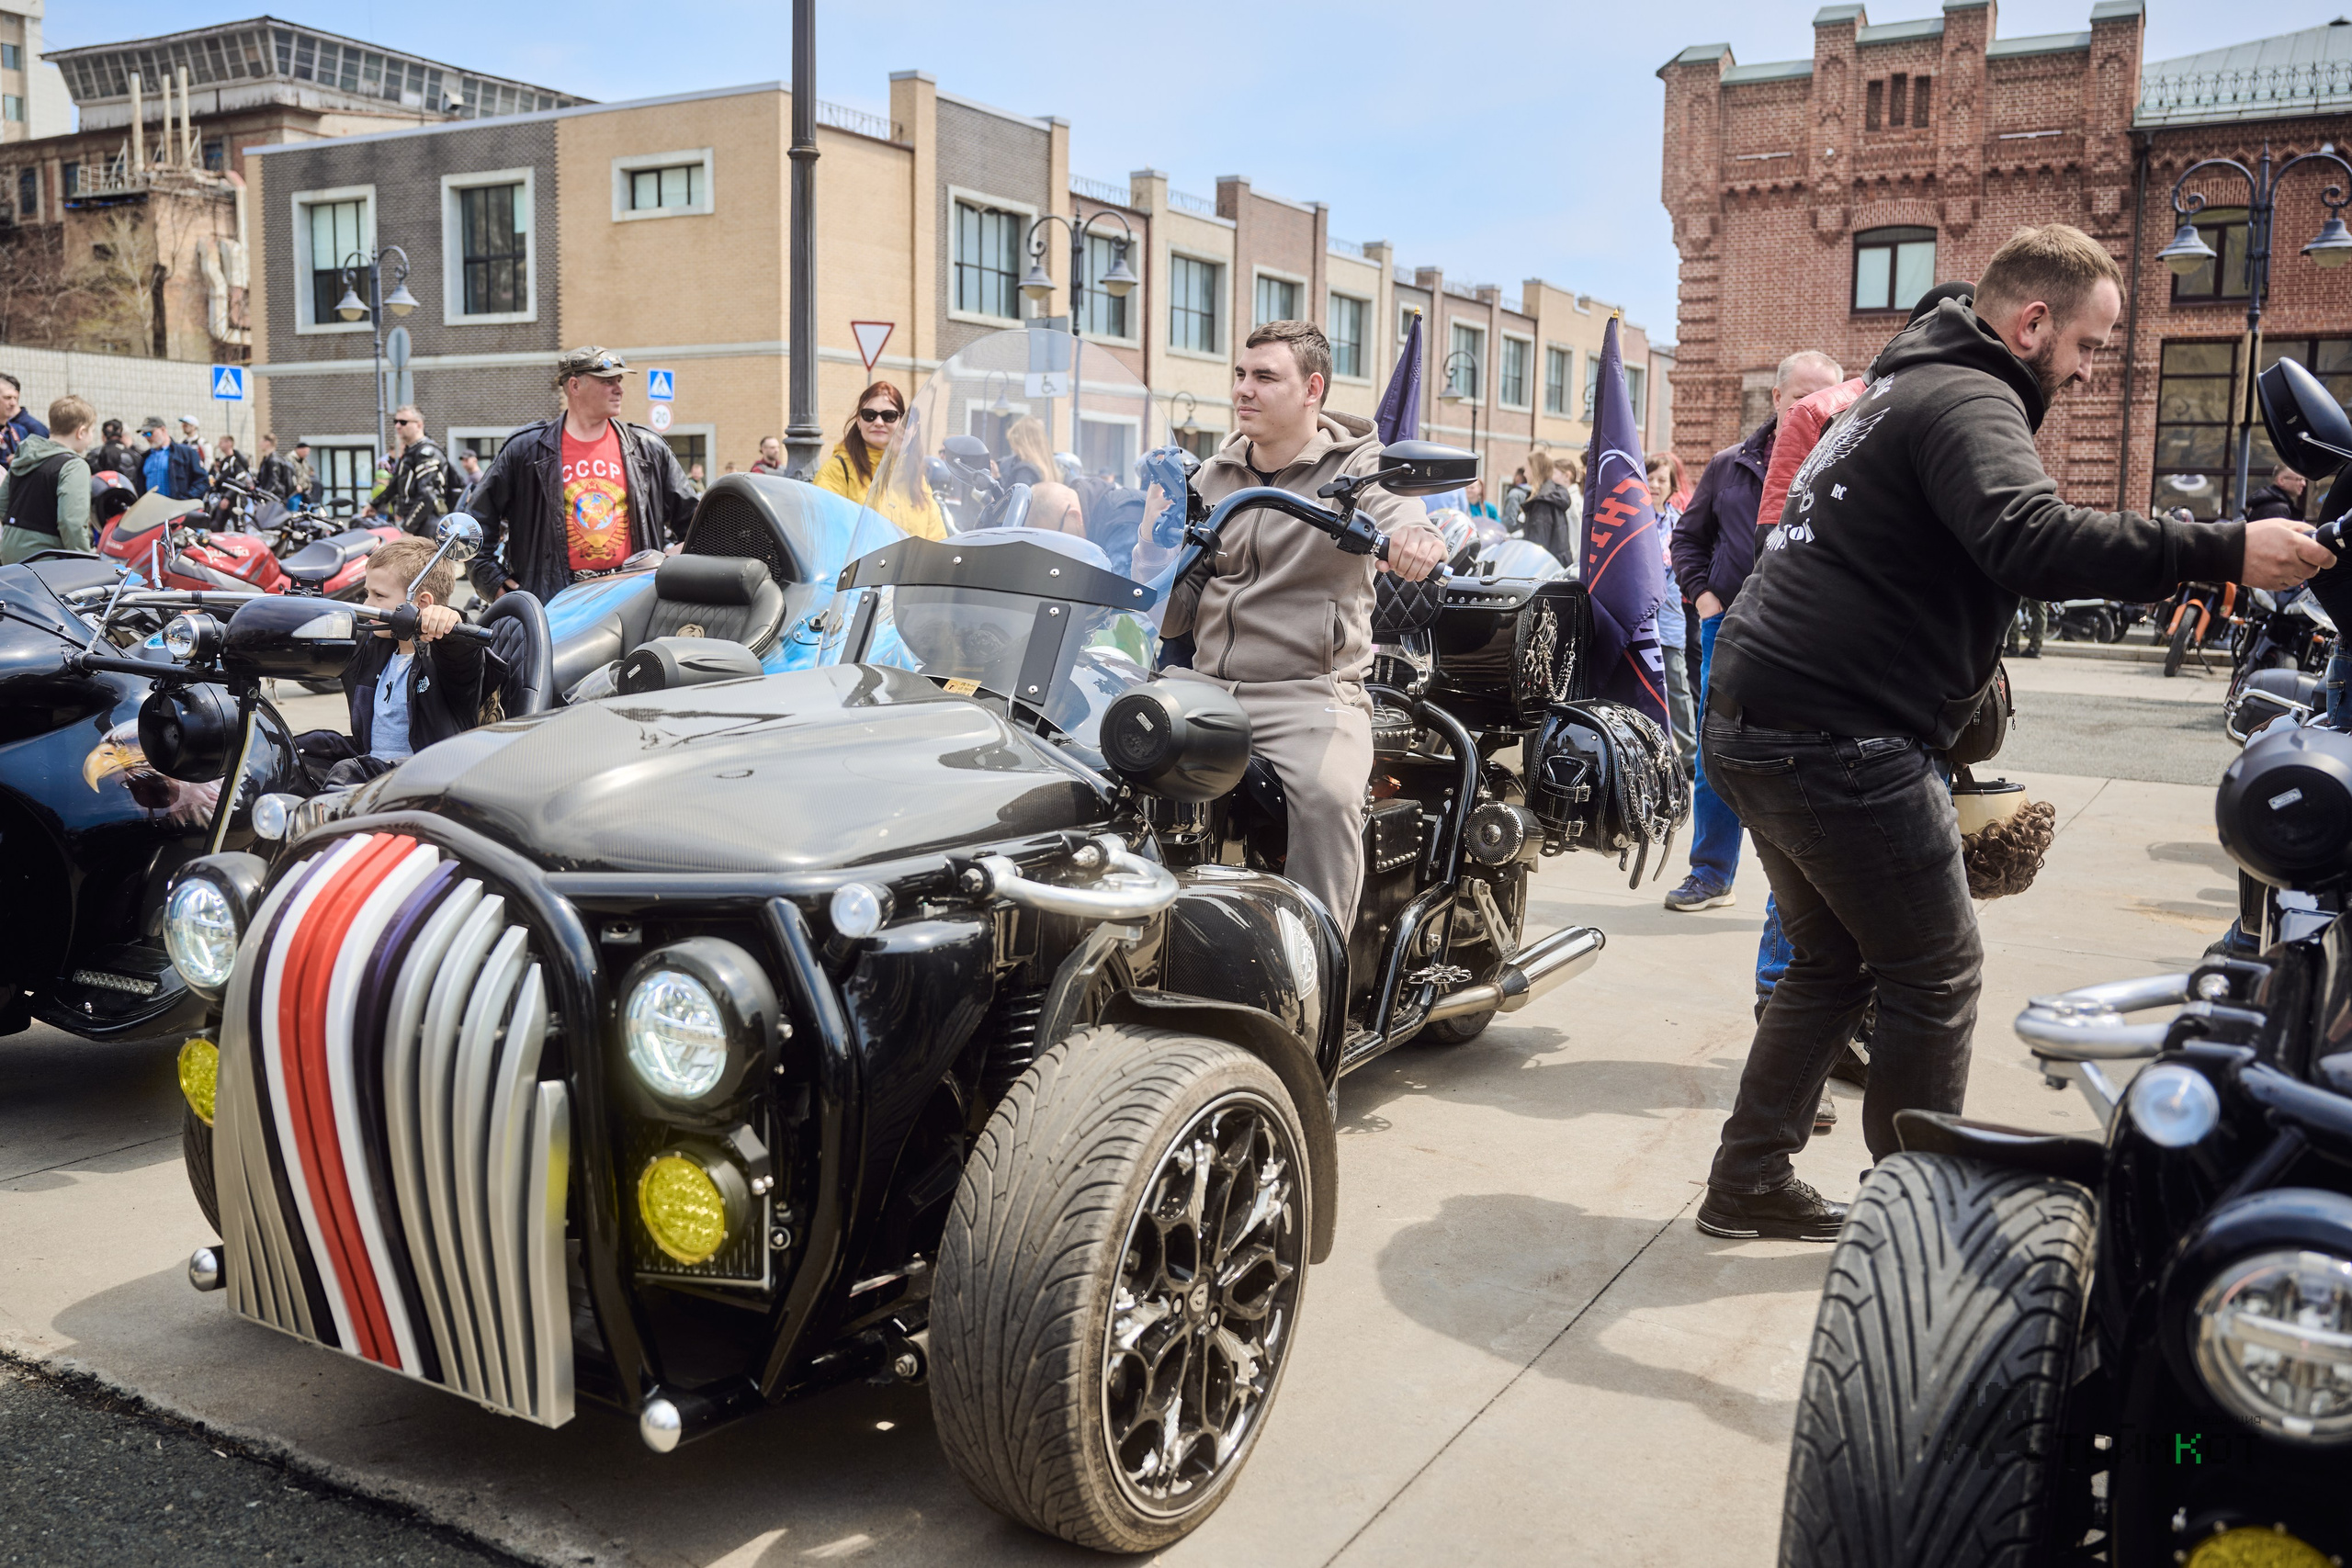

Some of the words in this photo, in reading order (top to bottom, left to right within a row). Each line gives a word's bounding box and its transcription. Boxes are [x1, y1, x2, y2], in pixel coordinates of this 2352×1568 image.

[655, 411, 668, 423] 20
[562, 459, 621, 482] СССР
[1830, 483, 1848, 501] RC
